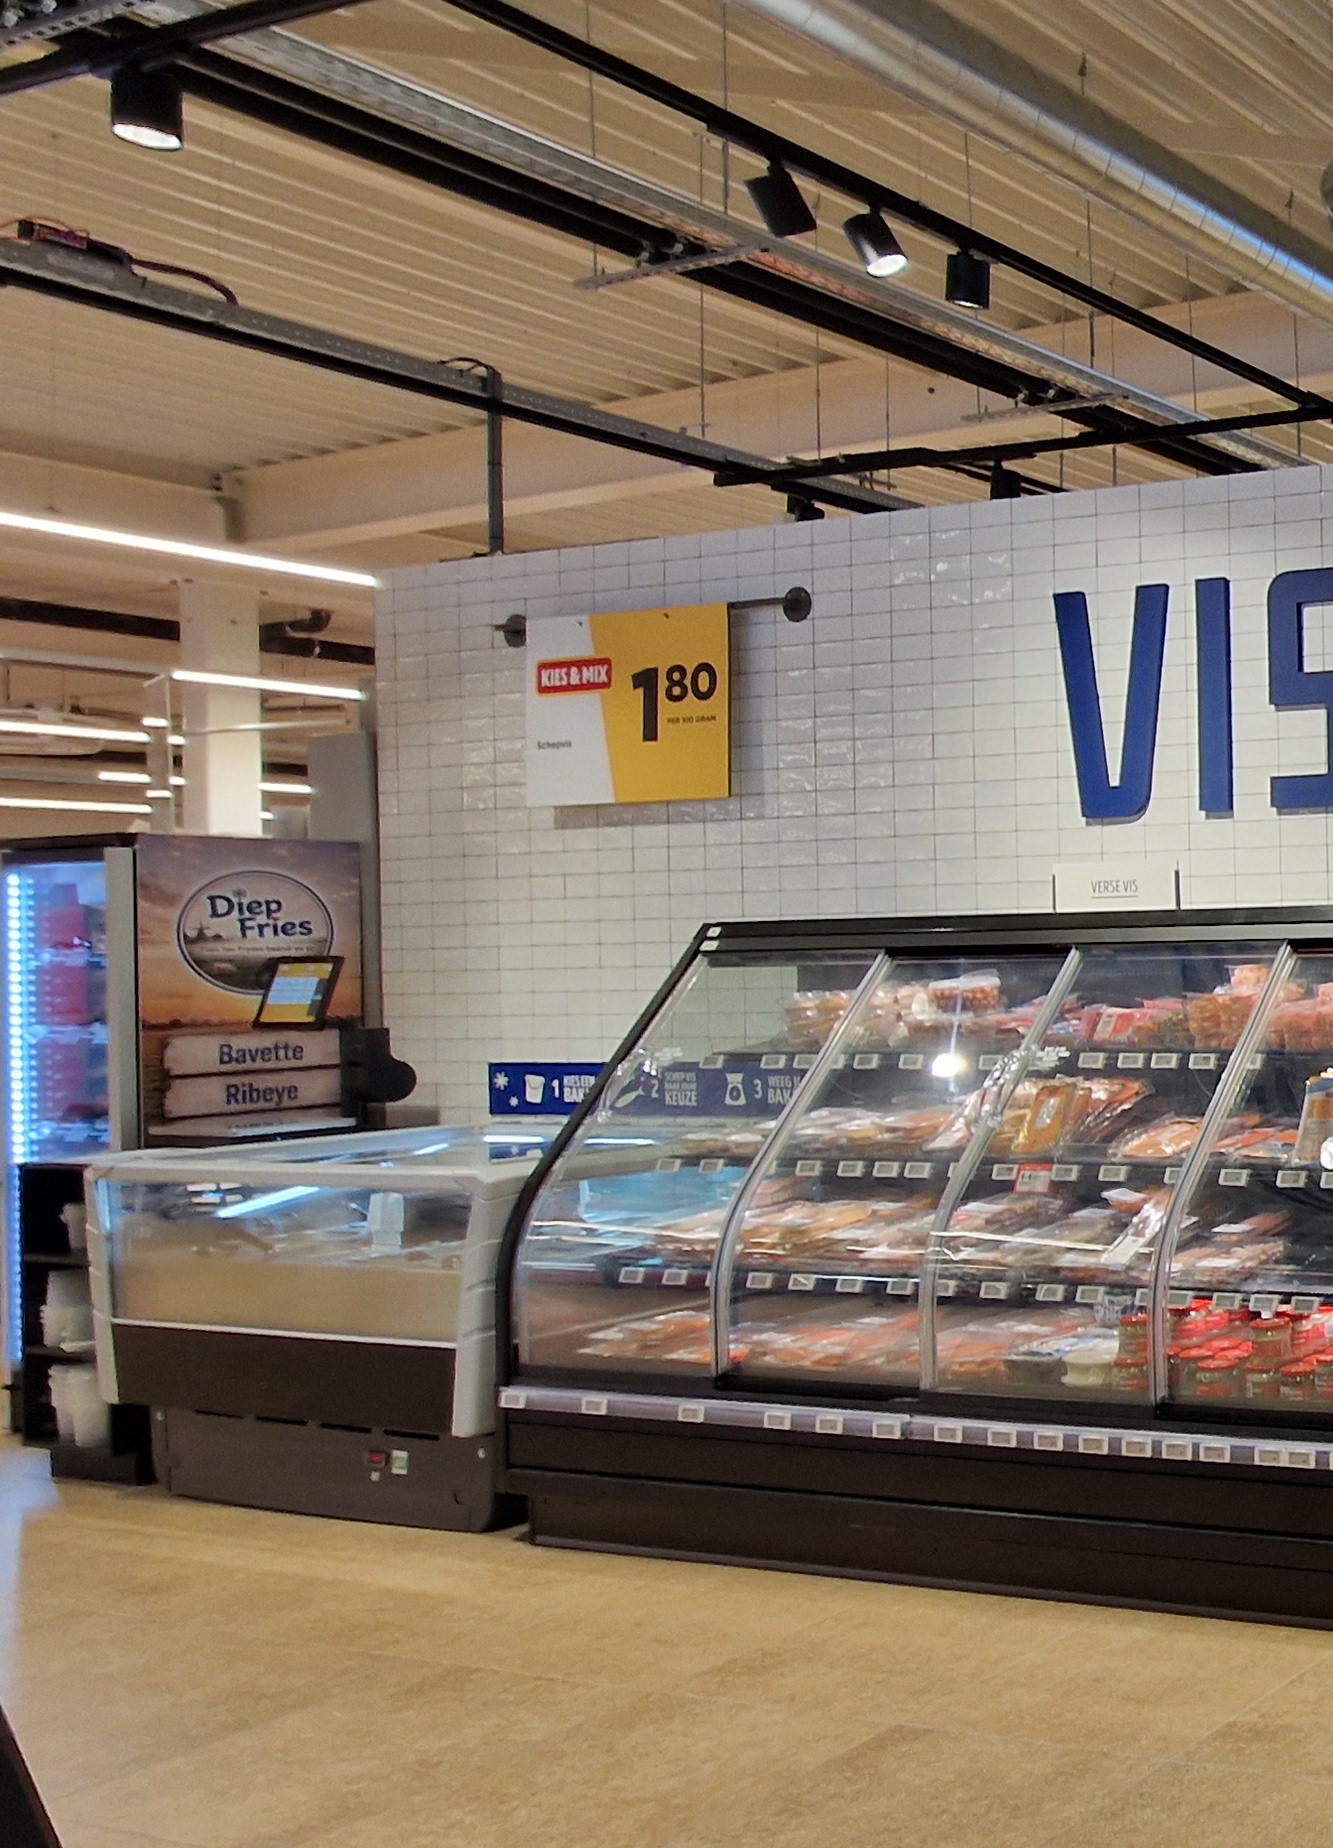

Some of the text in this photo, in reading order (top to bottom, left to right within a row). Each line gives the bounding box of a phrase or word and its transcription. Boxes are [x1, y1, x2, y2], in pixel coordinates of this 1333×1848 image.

[540, 664, 609, 688] KIES & MIX
[1091, 879, 1139, 894] VERSE VIS
[207, 892, 283, 920] Diep
[237, 917, 313, 939] Fries
[218, 1042, 304, 1065] Bavette
[551, 1078, 560, 1098] 1
[651, 1079, 660, 1099] 2
[753, 1079, 763, 1099] 3
[767, 1075, 792, 1088] WEEG
[226, 1082, 299, 1106] Ribeye
[664, 1091, 698, 1106] KEUZE
